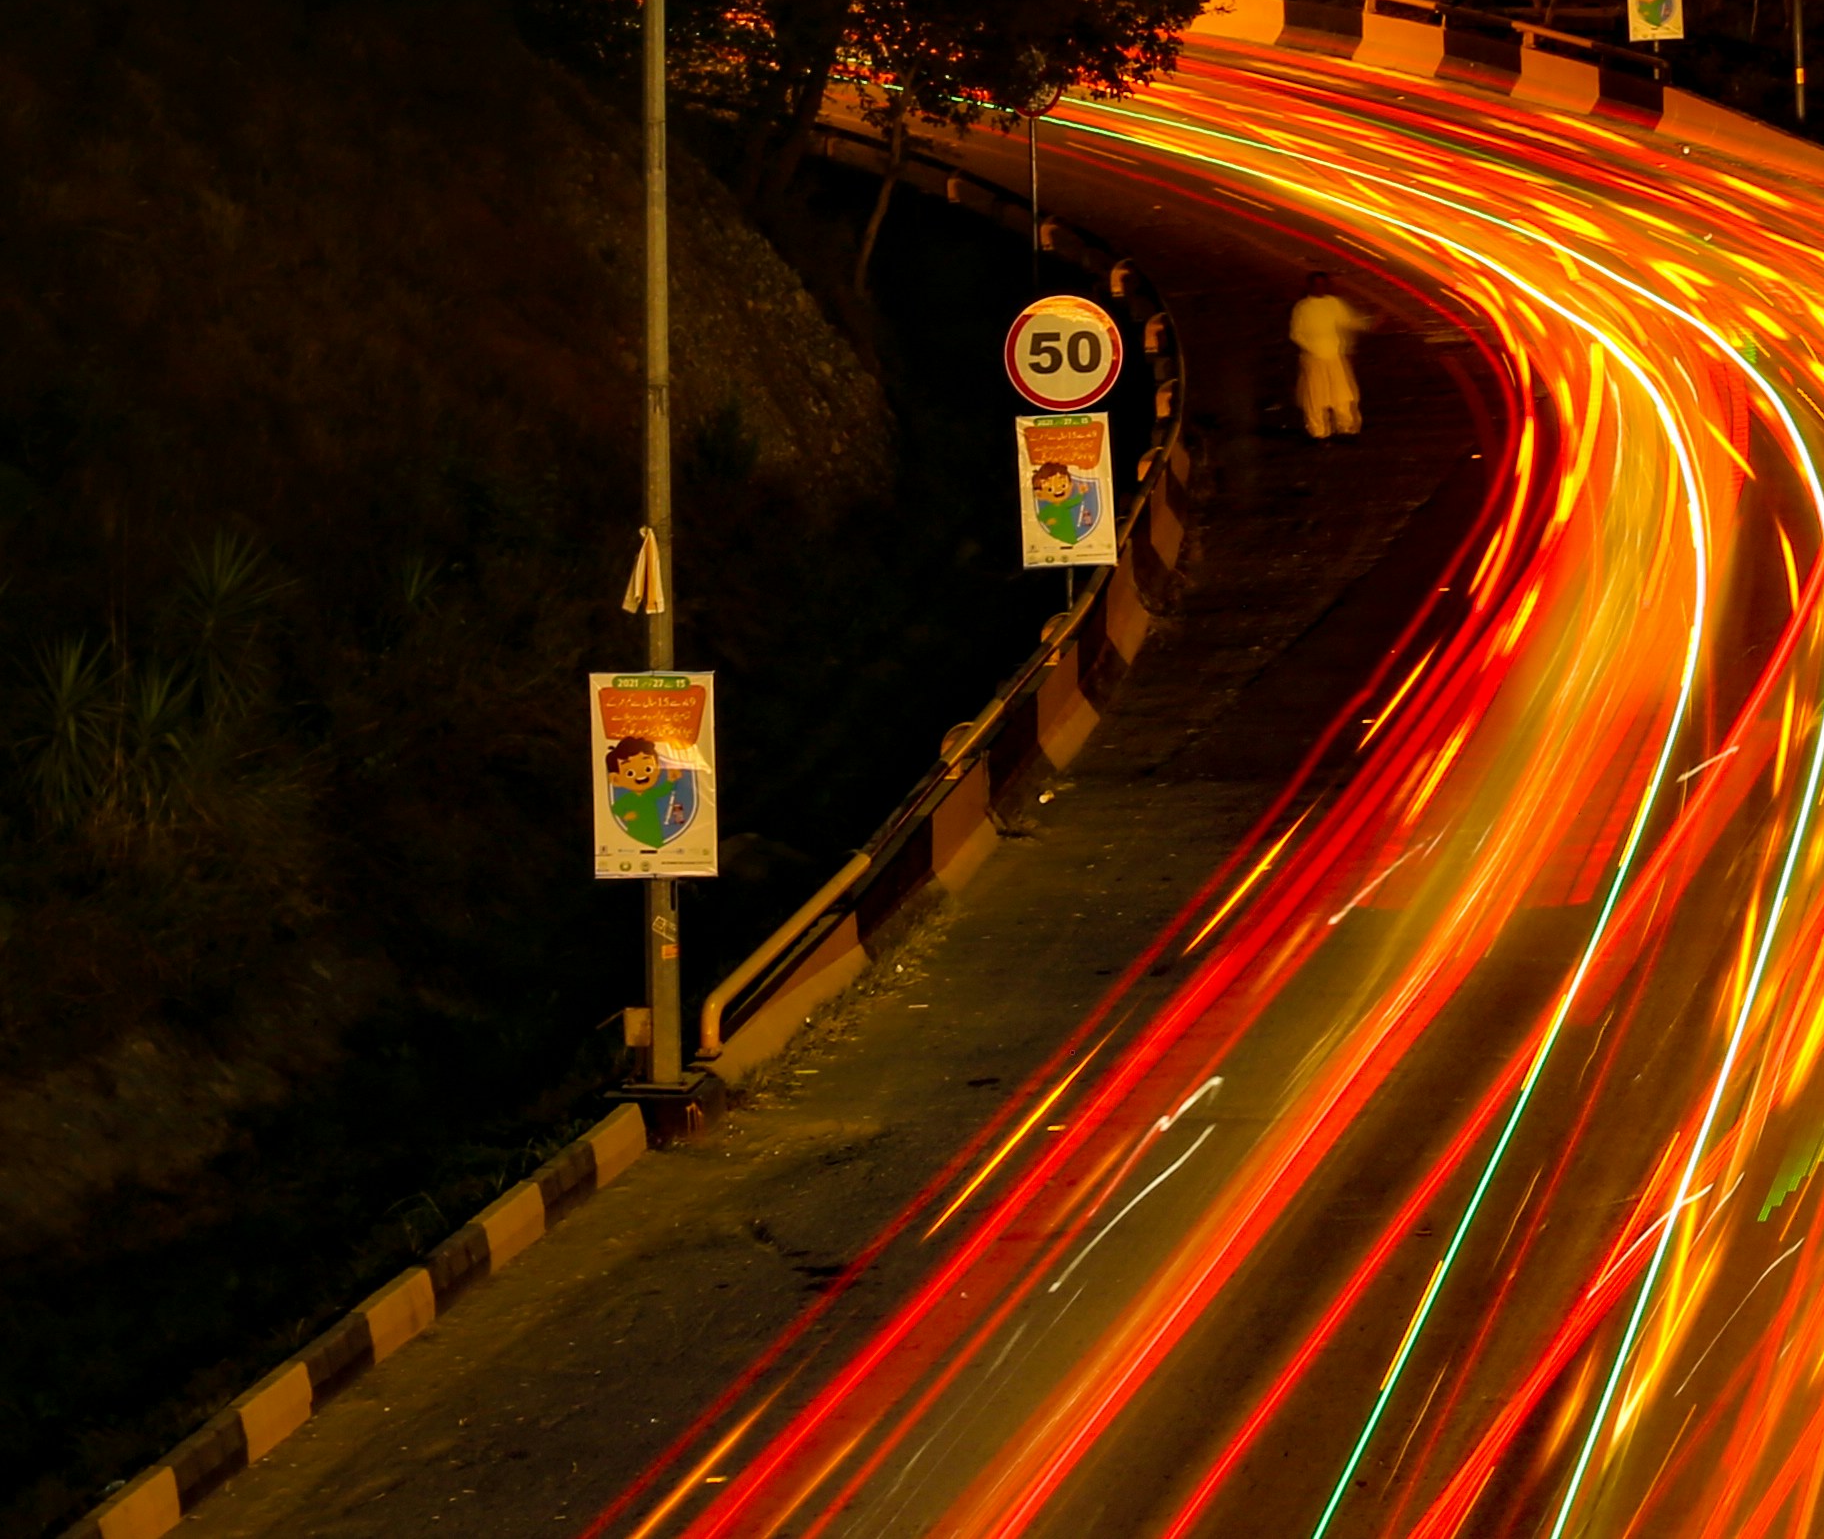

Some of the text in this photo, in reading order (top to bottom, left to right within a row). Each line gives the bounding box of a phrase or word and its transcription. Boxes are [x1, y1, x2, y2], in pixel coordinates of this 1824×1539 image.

[1027, 330, 1102, 375] 50
[617, 678, 639, 688] 2021
[652, 678, 664, 688] 27
[675, 678, 686, 688] 15
